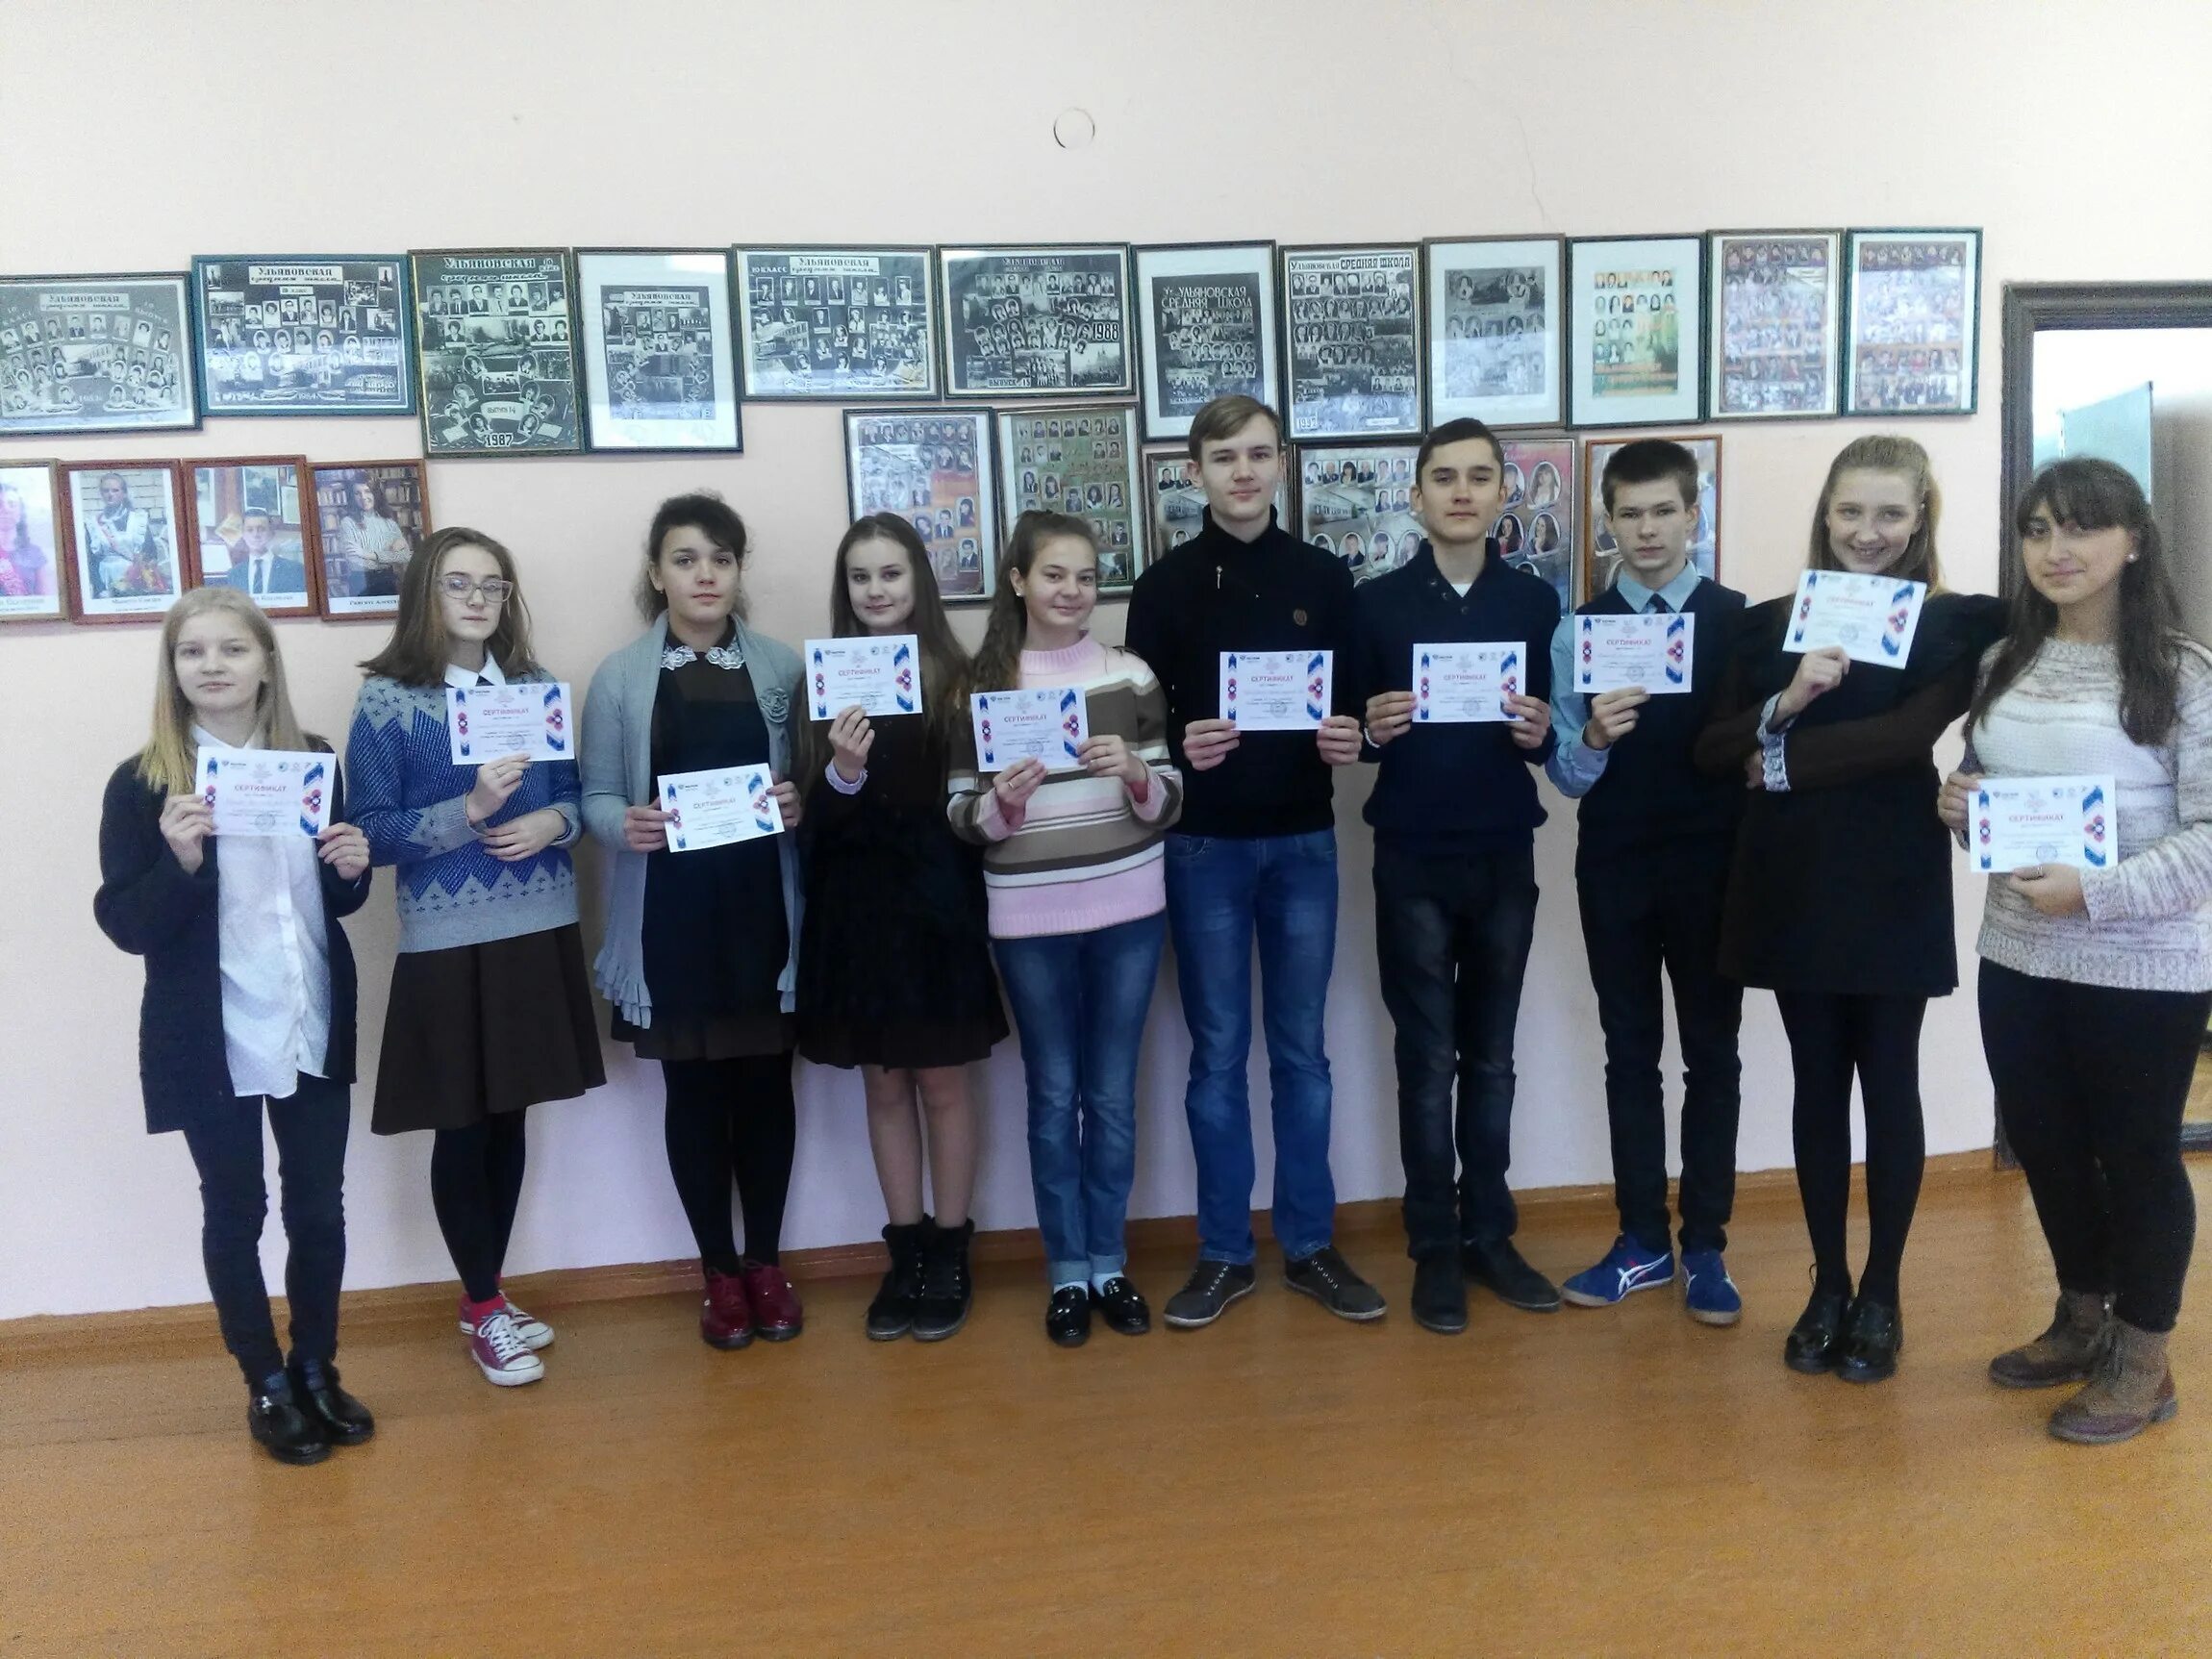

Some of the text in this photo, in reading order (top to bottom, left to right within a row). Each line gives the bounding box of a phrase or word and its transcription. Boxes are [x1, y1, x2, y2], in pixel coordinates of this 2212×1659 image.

[1341, 258, 1377, 269] СРЕДНЯЯ
[1379, 256, 1410, 267] ШКОЛА
[1178, 286, 1246, 298] УЛЬЯНОВСКАЯ
[1162, 296, 1252, 308] СРЕДНЯЯ ШКОЛА
[1092, 322, 1119, 340] 1988
[485, 433, 513, 447] 1987
[1004, 715, 1047, 723] СЕРТИФИКАТ
[2009, 814, 2064, 823] СЕРТИФИКАТ
